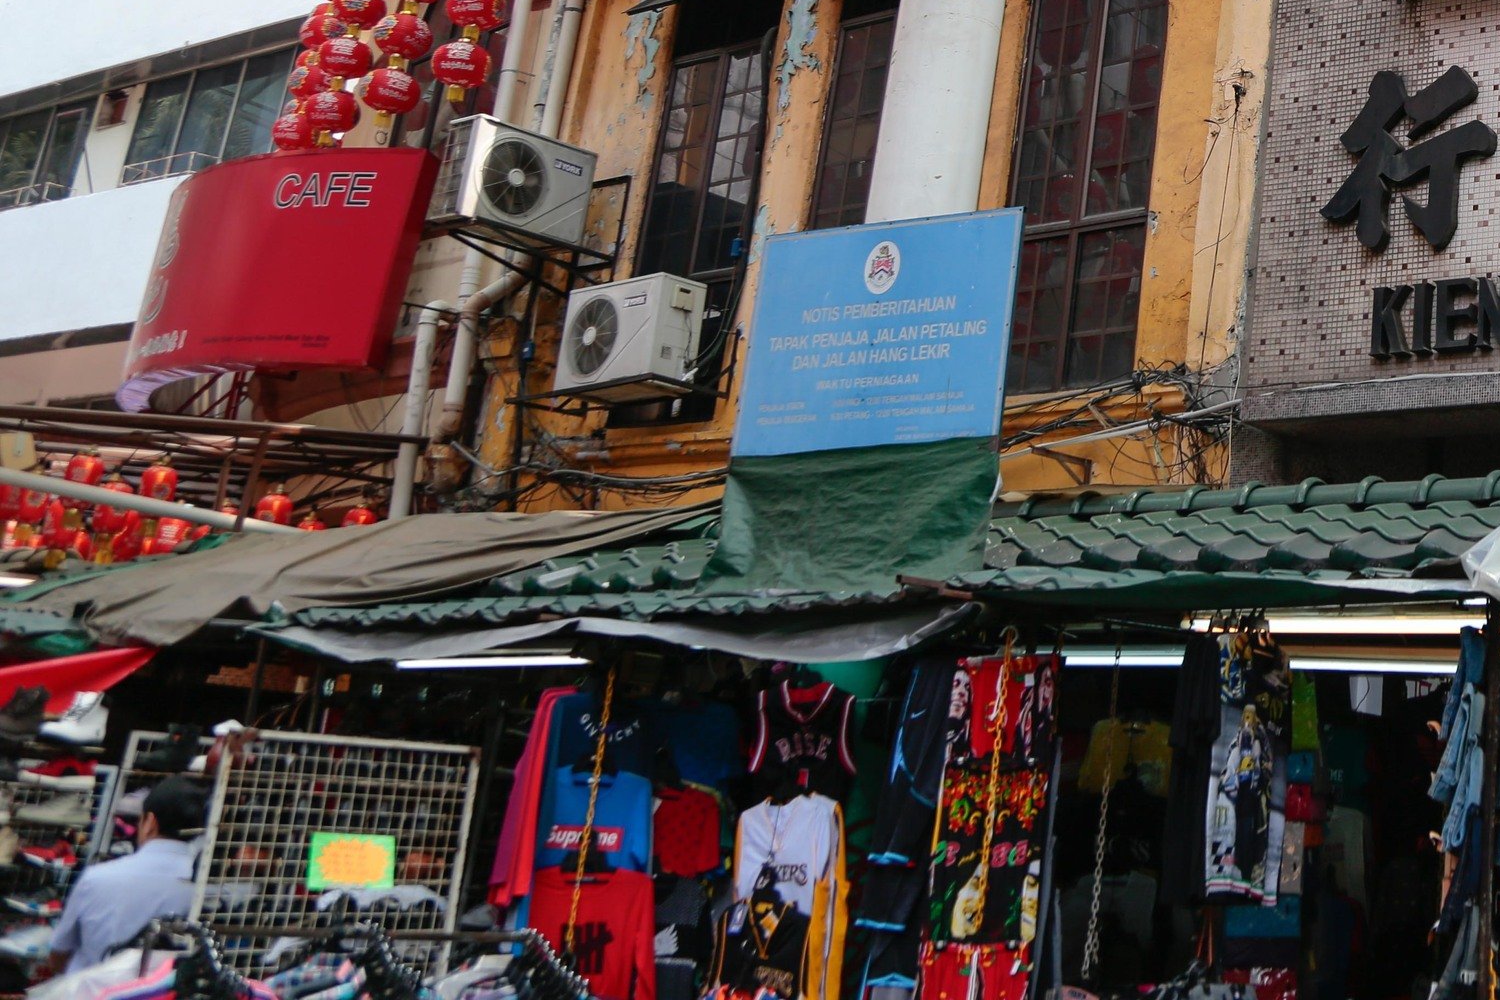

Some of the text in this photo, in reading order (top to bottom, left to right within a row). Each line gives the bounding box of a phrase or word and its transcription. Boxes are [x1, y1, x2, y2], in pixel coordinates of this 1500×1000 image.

[560, 161, 582, 176] YORK
[273, 171, 378, 209] CAFE
[801, 295, 957, 325] NOTIS PEMBERITAHUAN
[769, 319, 988, 352] TAPAK PENJAJA JALAN PETALING
[791, 342, 951, 372] DAN JALAN HANG LEKIR
[547, 824, 619, 849] Suprme
